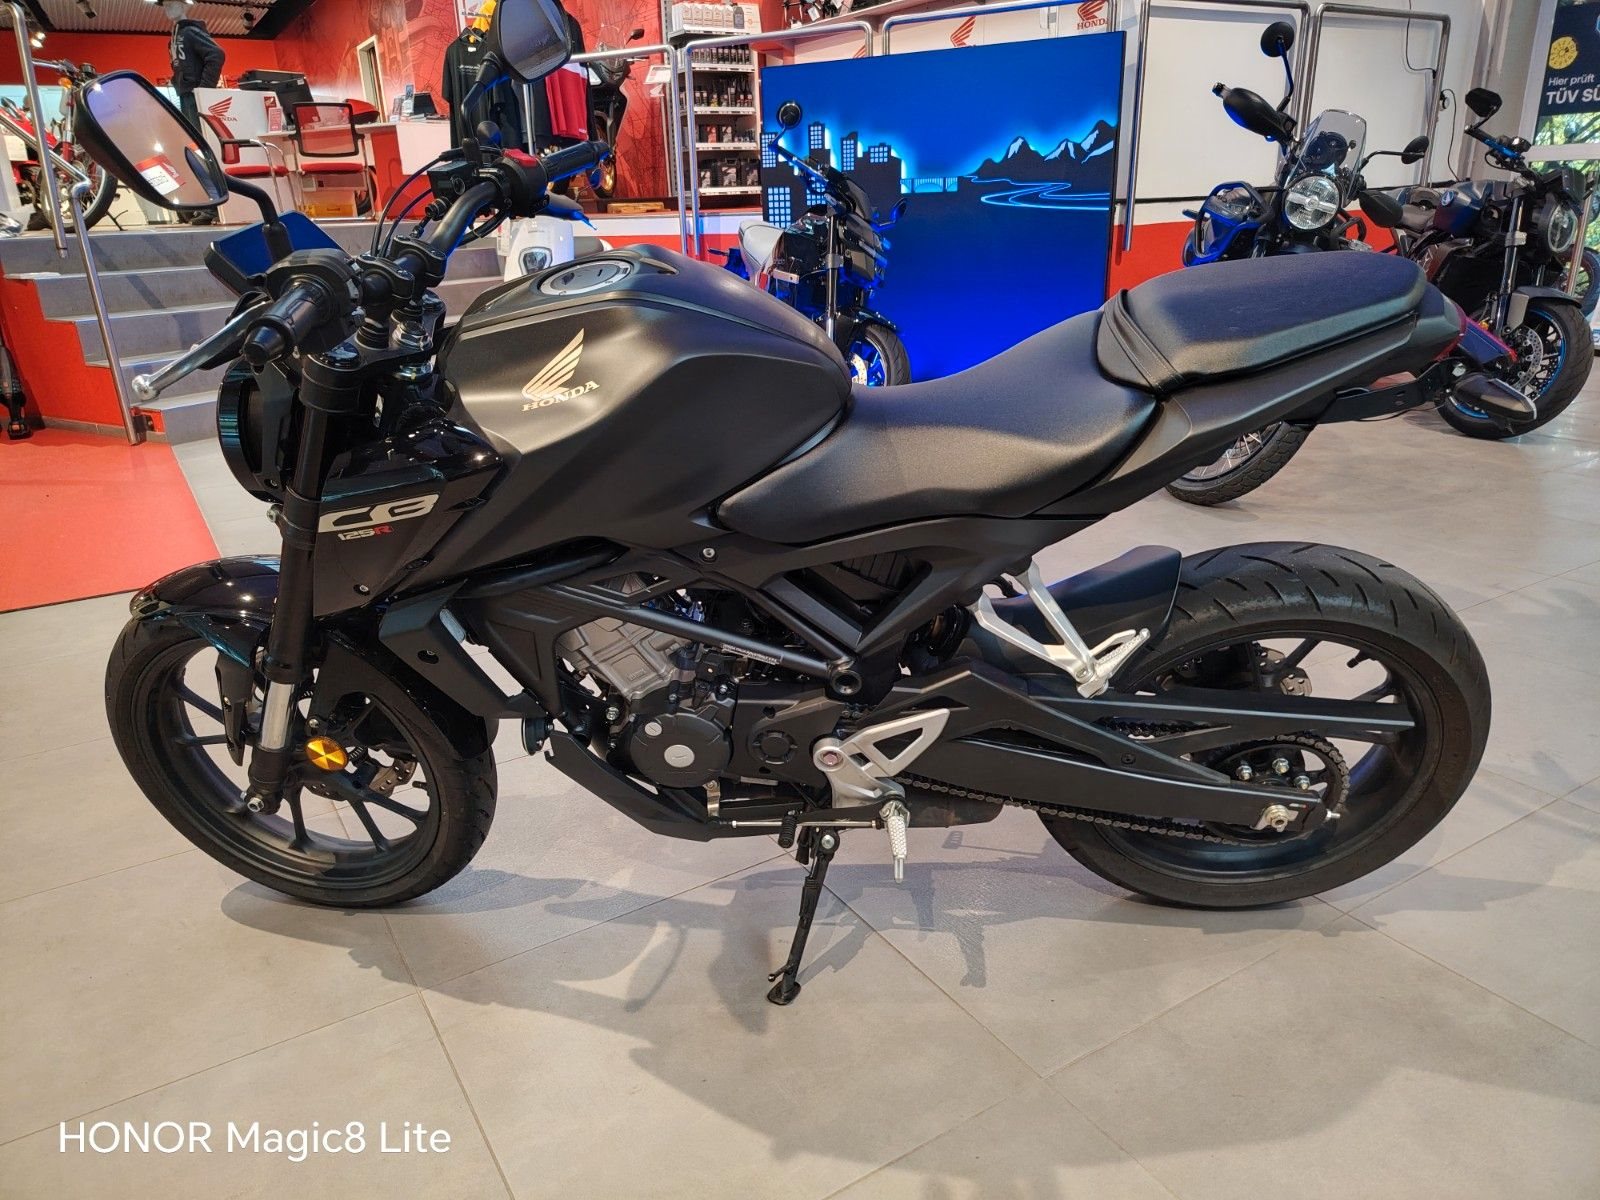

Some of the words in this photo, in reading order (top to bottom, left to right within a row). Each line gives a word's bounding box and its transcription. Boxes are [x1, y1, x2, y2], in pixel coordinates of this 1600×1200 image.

[1548, 77, 1568, 86] Hier
[1570, 74, 1595, 86] prüft
[1546, 87, 1579, 105] TÜV
[521, 381, 600, 411] HONDA
[318, 494, 439, 532] CB
[338, 524, 394, 540] 125R
